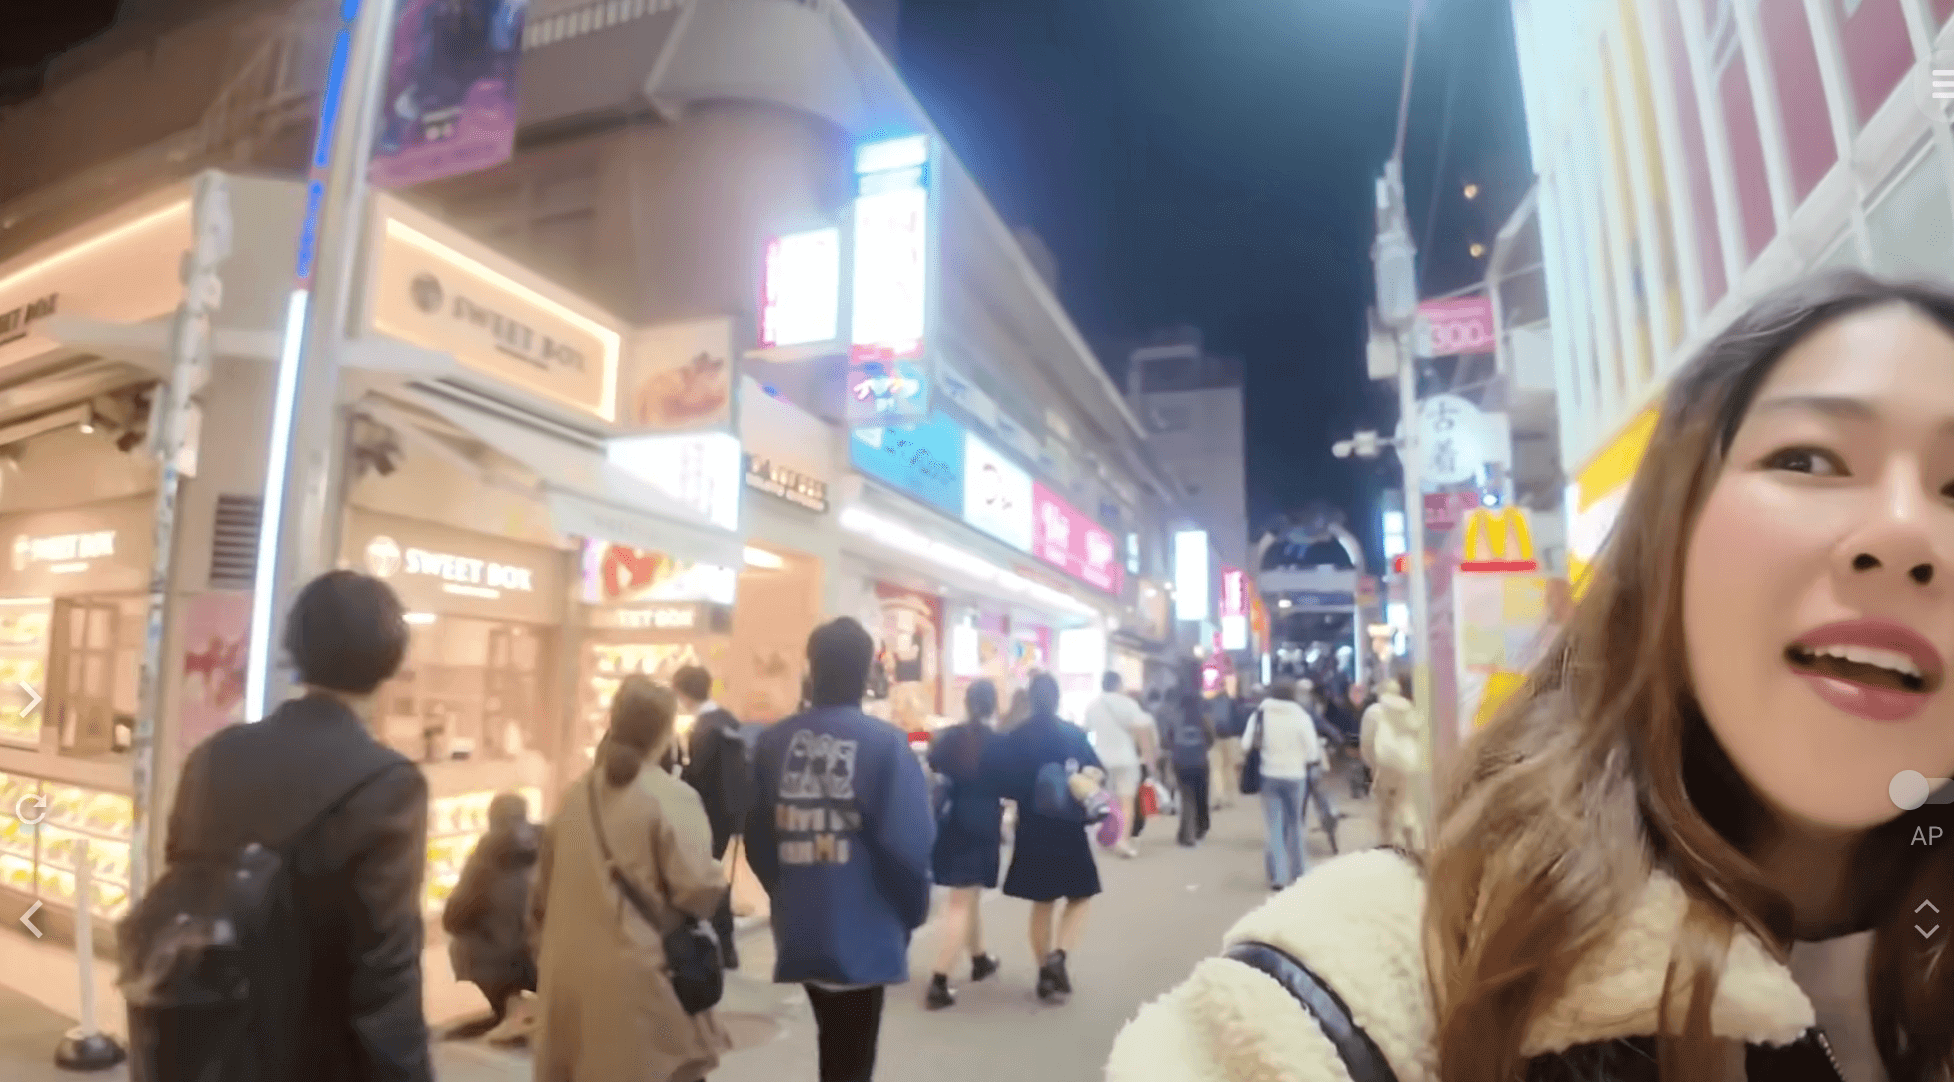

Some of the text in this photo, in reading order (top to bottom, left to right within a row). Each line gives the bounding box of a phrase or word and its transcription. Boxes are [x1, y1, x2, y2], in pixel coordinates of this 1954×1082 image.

[453, 295, 533, 351] SWEET
[543, 334, 586, 374] BOX
[405, 548, 484, 584] SWEET
[487, 562, 533, 592] BOX
